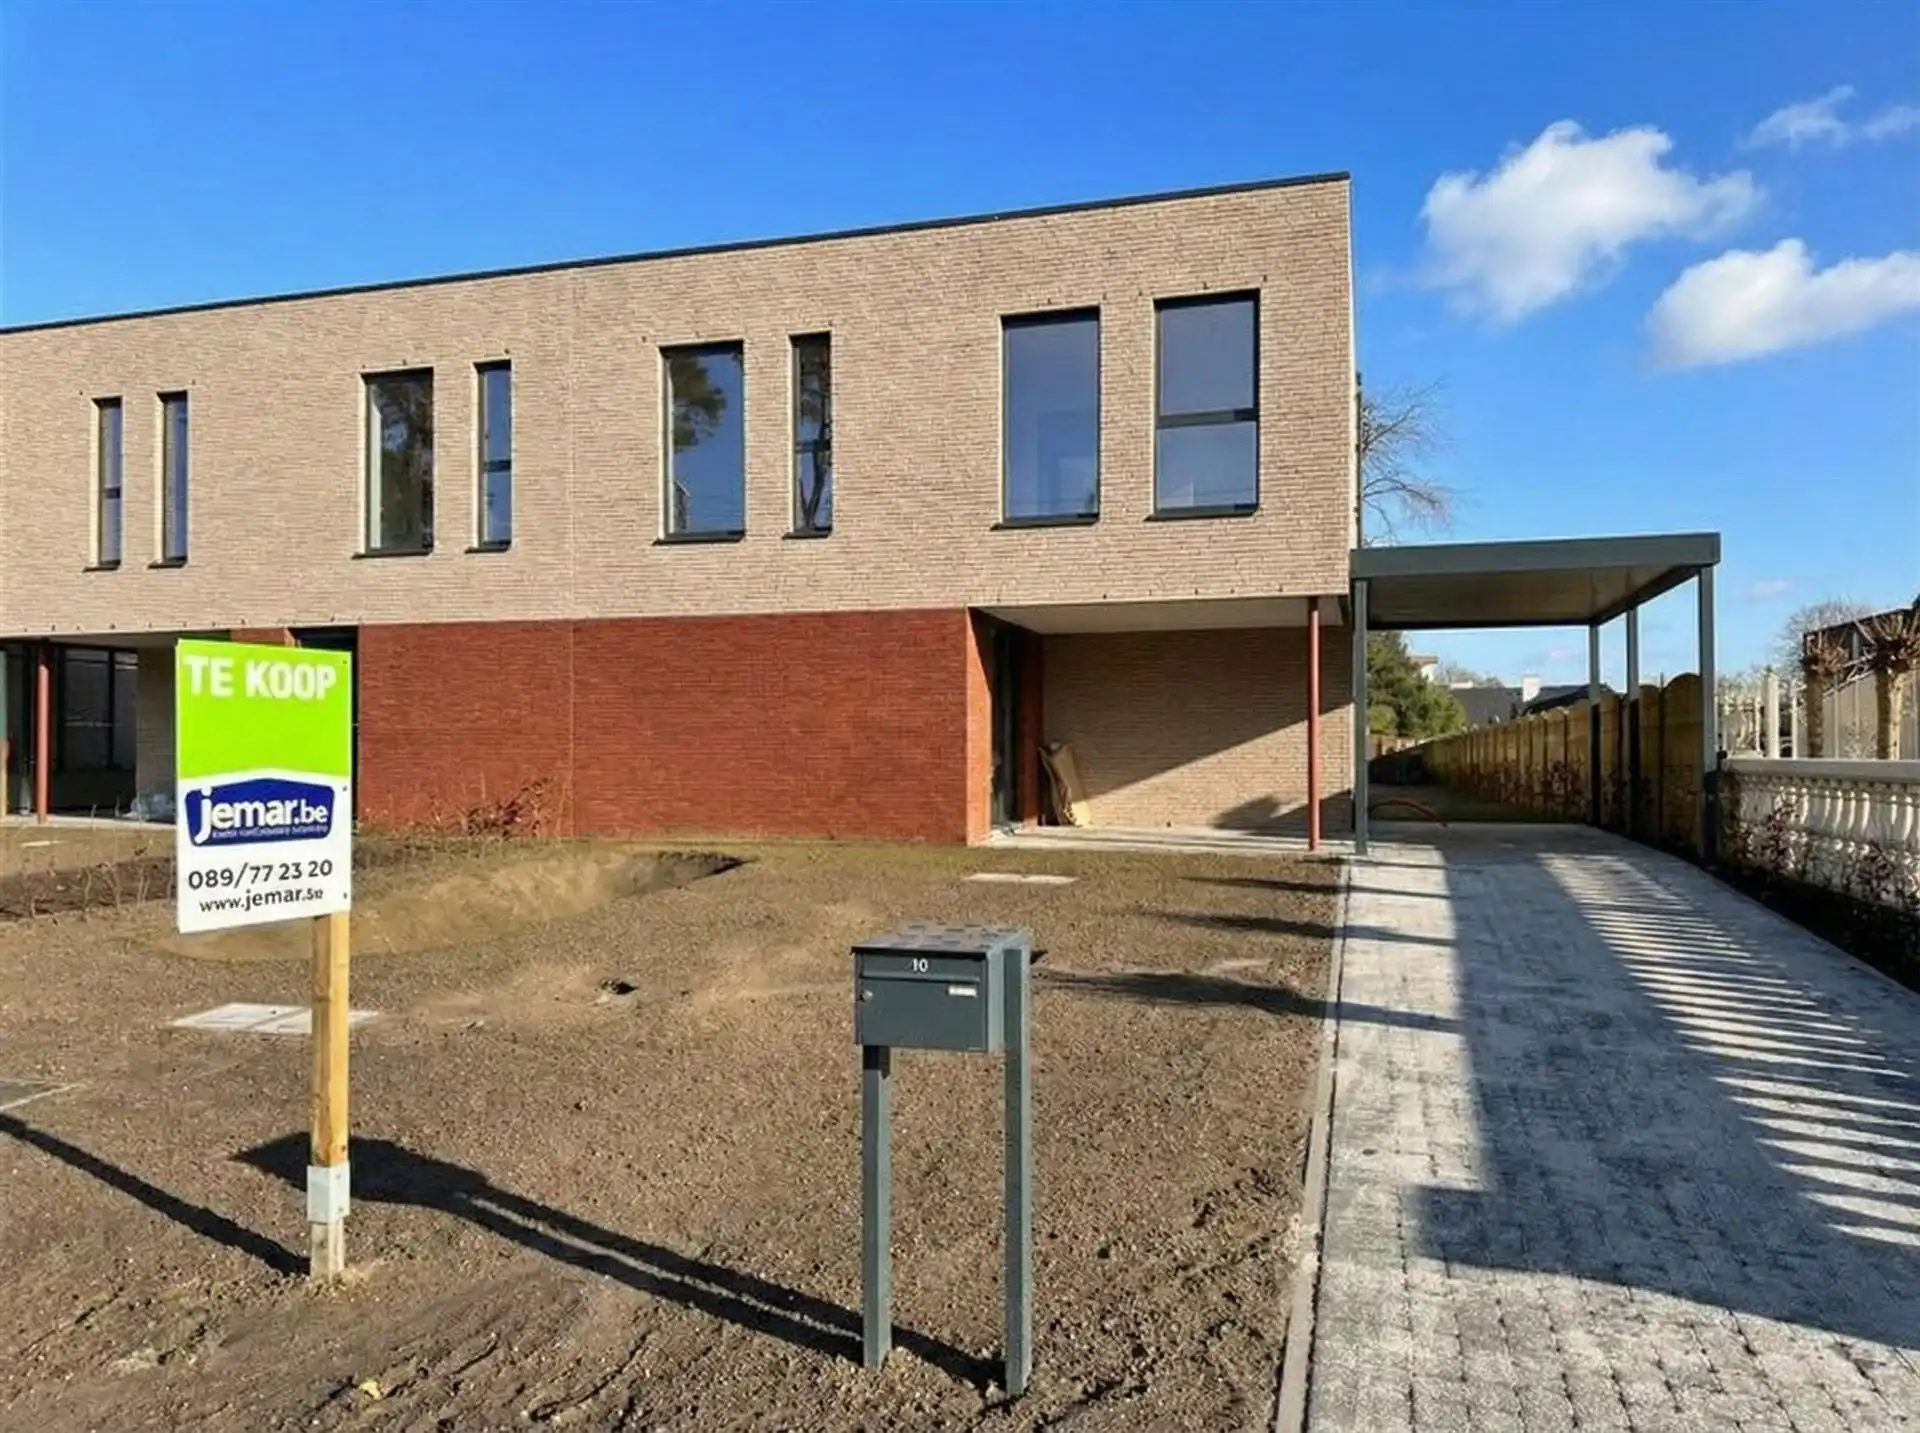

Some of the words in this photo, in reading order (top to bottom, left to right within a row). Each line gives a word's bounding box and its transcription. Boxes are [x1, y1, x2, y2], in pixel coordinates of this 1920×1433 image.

[184, 655, 233, 697] TE
[246, 659, 337, 699] KOOP
[194, 786, 329, 845] jemar.be
[188, 861, 274, 891] 089/77
[278, 861, 303, 881] 23
[308, 859, 333, 877] 20
[912, 957, 929, 973] 10
